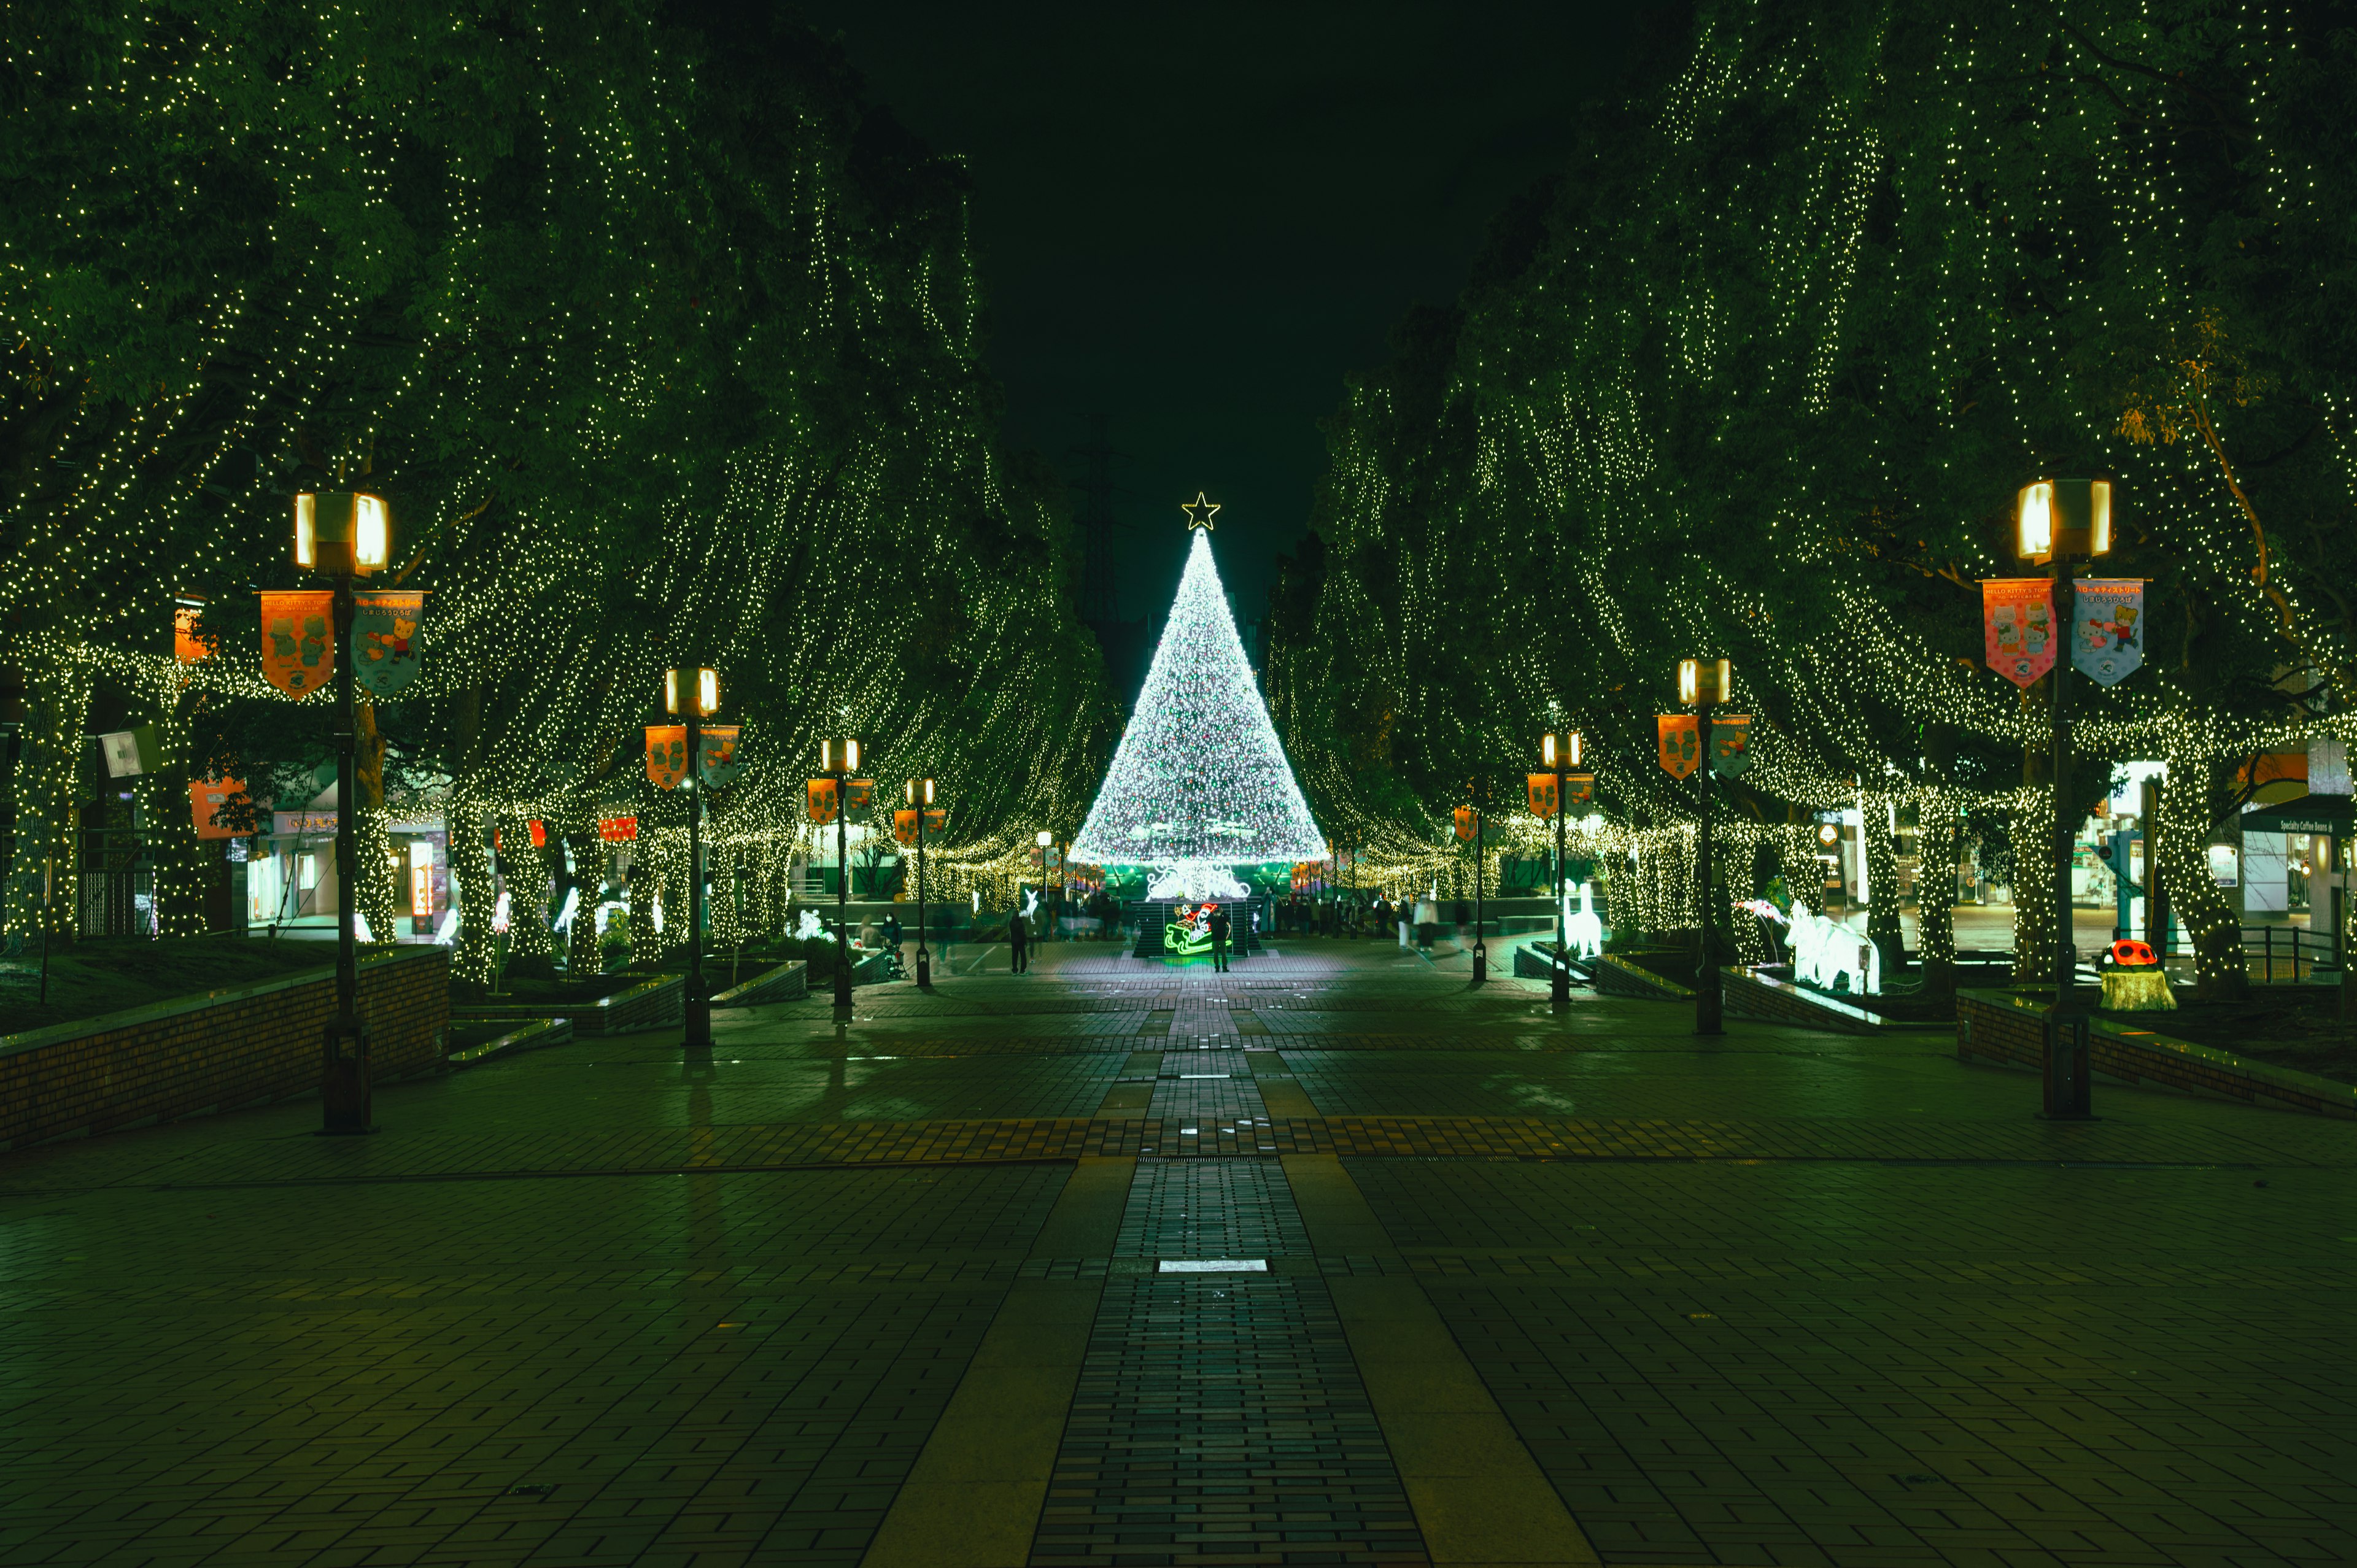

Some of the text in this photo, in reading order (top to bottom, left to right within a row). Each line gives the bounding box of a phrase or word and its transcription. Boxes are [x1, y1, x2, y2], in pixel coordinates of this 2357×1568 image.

[355, 598, 422, 607] ハローキティストリート
[2280, 820, 2328, 832] Specialty Coffee Beans
